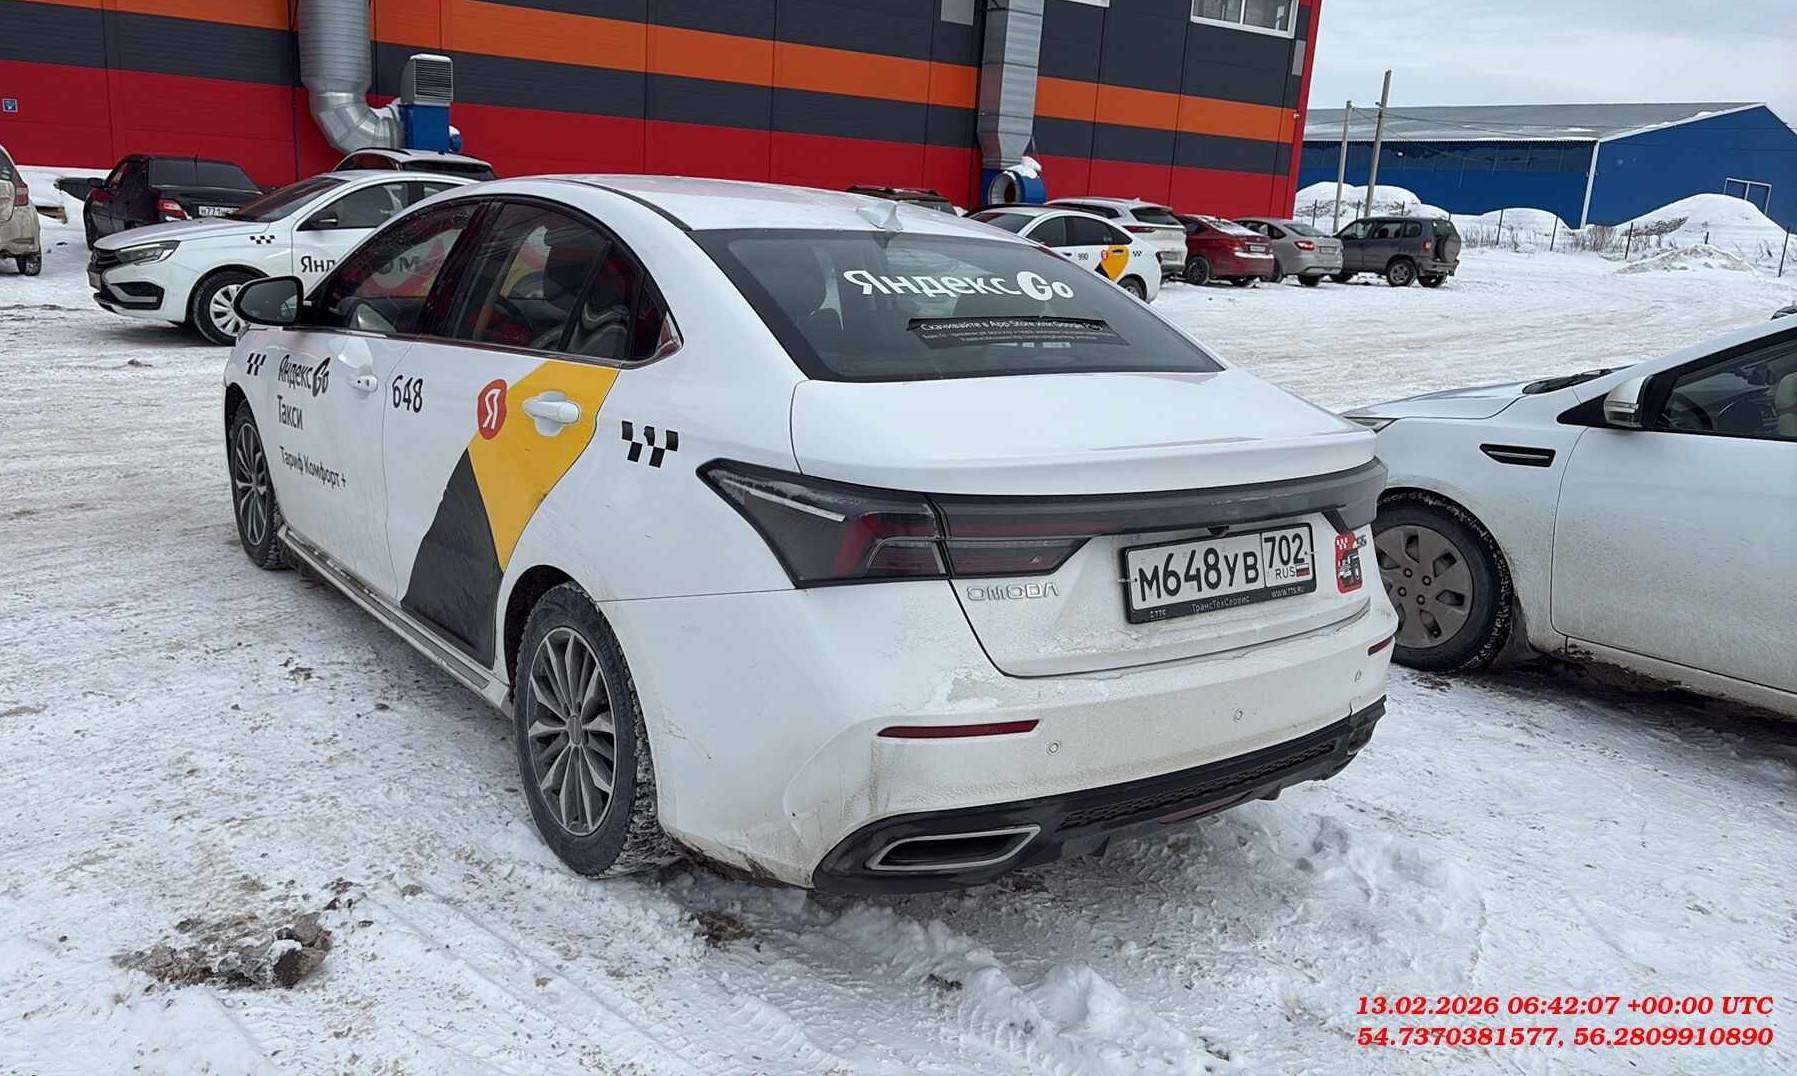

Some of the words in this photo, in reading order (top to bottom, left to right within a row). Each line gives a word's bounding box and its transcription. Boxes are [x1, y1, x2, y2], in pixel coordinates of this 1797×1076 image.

[843, 270, 1022, 297] Яндекс
[1016, 271, 1074, 301] Go
[278, 354, 313, 389] Яндекс
[312, 356, 331, 398] Go
[392, 375, 423, 413] 648
[277, 395, 304, 430] Такси
[280, 445, 304, 476] Тариф
[1138, 547, 1260, 602] М648УВ
[1263, 533, 1306, 569] 702
[1275, 567, 1296, 580] RUS
